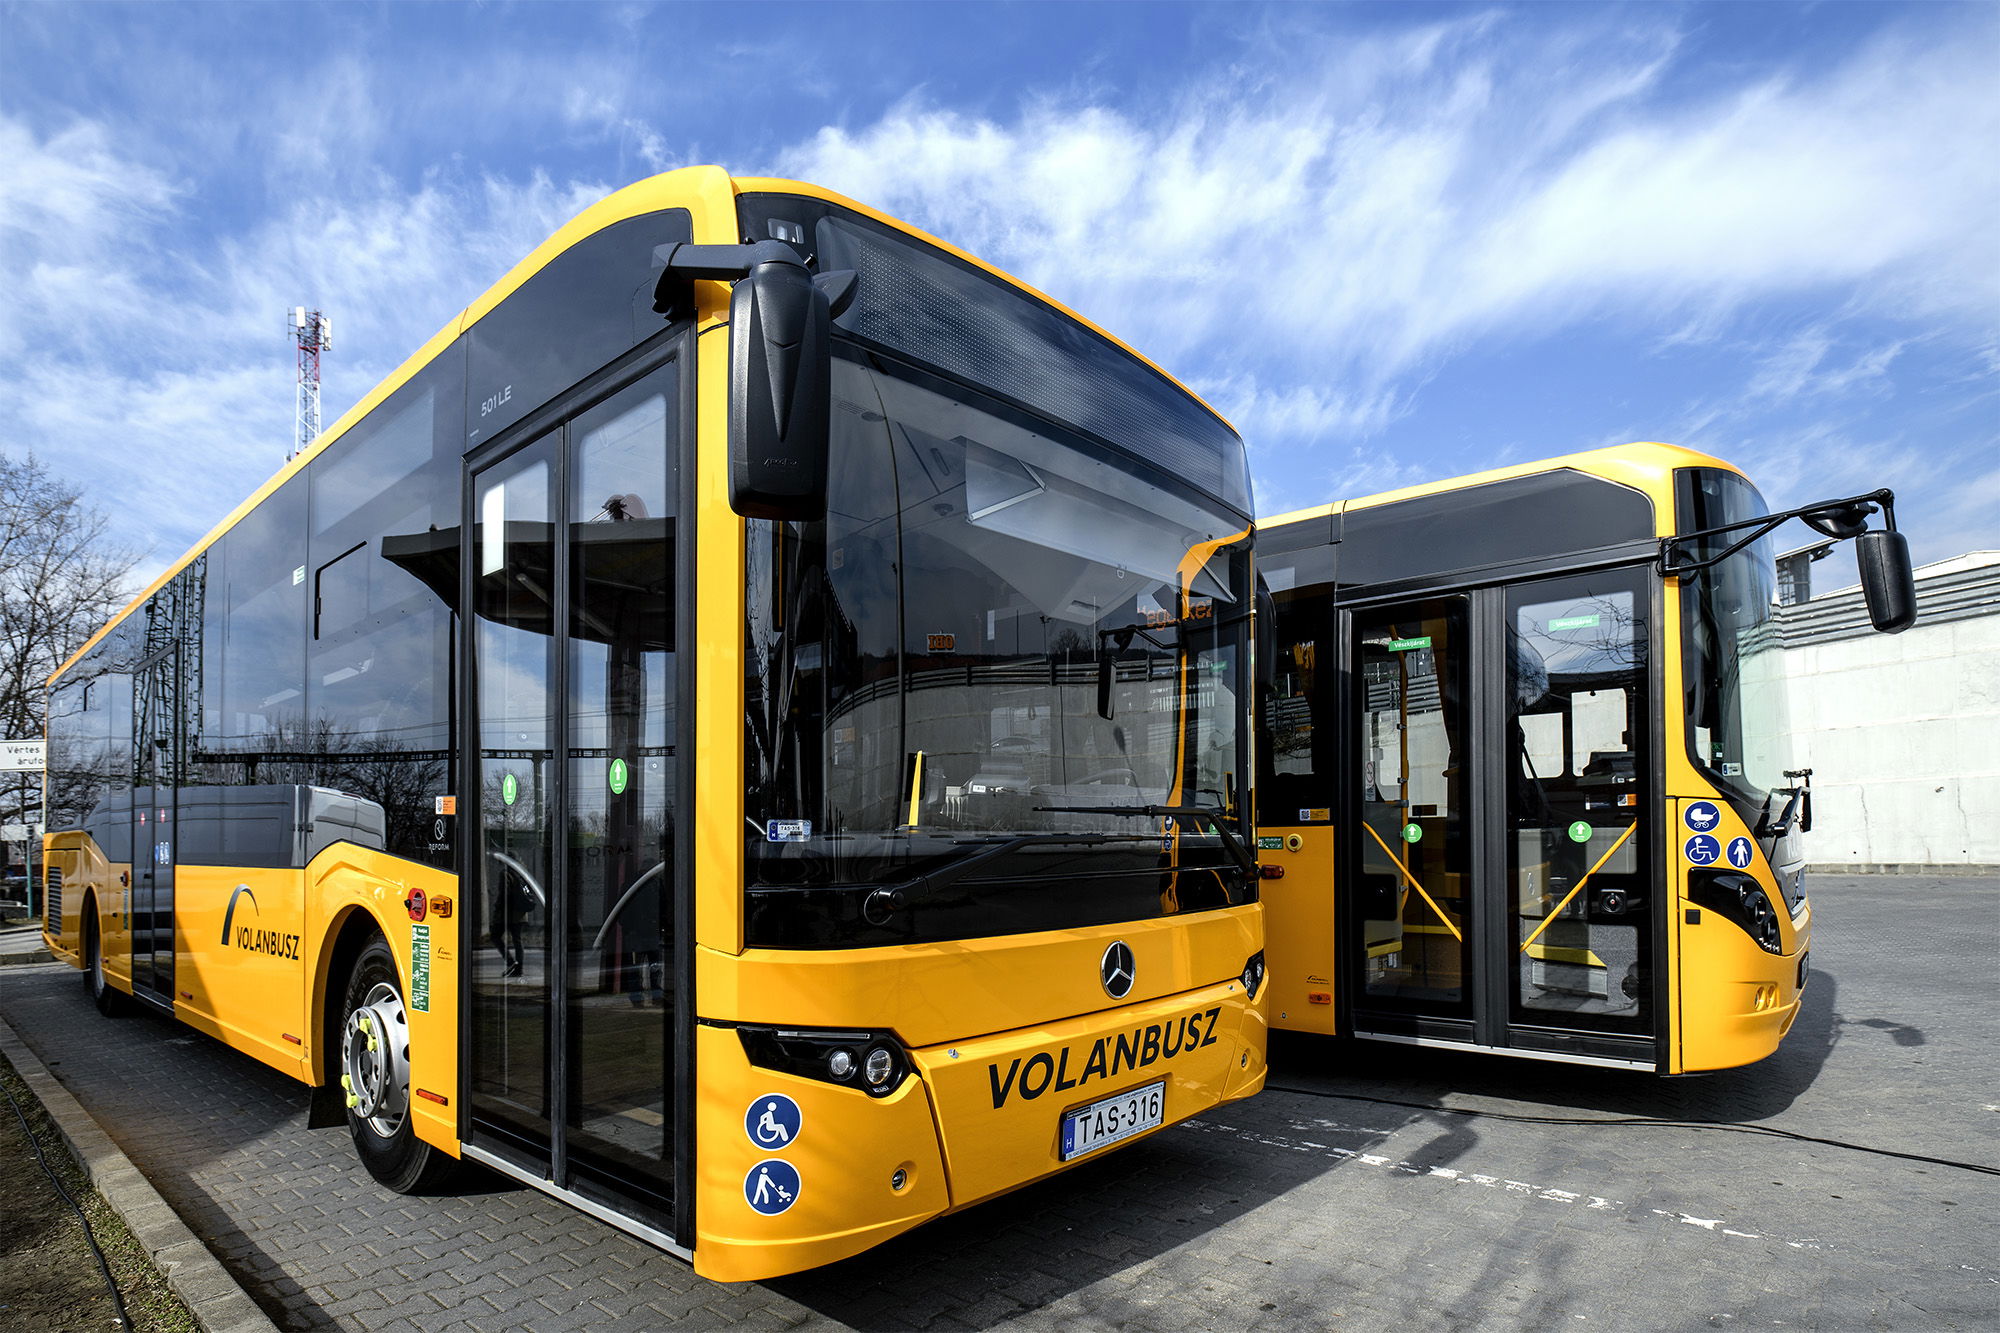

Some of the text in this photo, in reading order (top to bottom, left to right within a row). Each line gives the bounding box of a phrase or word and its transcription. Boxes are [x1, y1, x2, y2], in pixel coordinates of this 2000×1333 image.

[988, 1006, 1222, 1110] VOLÁNBUSZ
[1066, 1138, 1073, 1149] H
[1079, 1091, 1159, 1144] TAS-316
